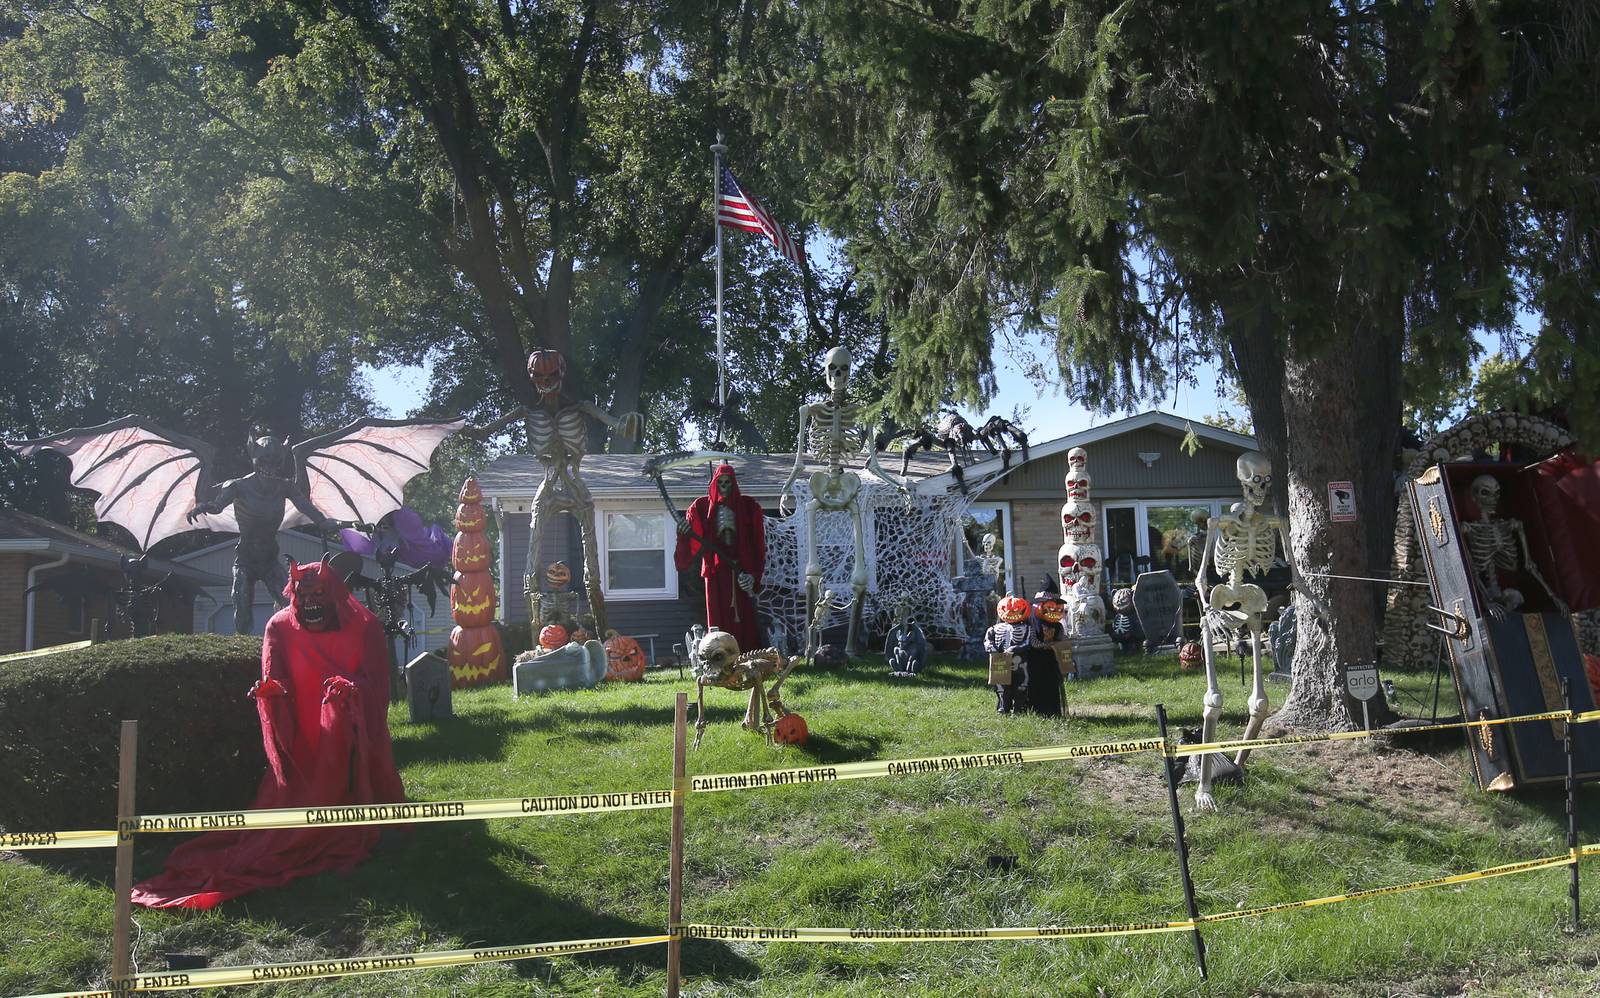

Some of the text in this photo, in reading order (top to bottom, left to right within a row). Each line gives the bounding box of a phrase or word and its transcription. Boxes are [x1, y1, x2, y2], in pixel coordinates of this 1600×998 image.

[1350, 674, 1375, 687] arlo
[1070, 744, 1118, 757] CAUTION
[888, 752, 1024, 776] CAUTION DO NOT ENTER
[692, 767, 837, 791] CAUTION DO NOT ENTER
[521, 791, 672, 813] CAUTION DO NOT ENTER
[143, 818, 164, 830] DO
[169, 816, 197, 829] NOT
[200, 814, 246, 828] ENTER
[306, 802, 465, 824] CAUTION DO NOT ENTER
[710, 926, 728, 939] DO
[731, 927, 755, 939] NOT
[759, 928, 798, 939] ENTER
[252, 956, 416, 980] CAUTION DO NOT ENTER
[143, 974, 190, 989] ENTER
